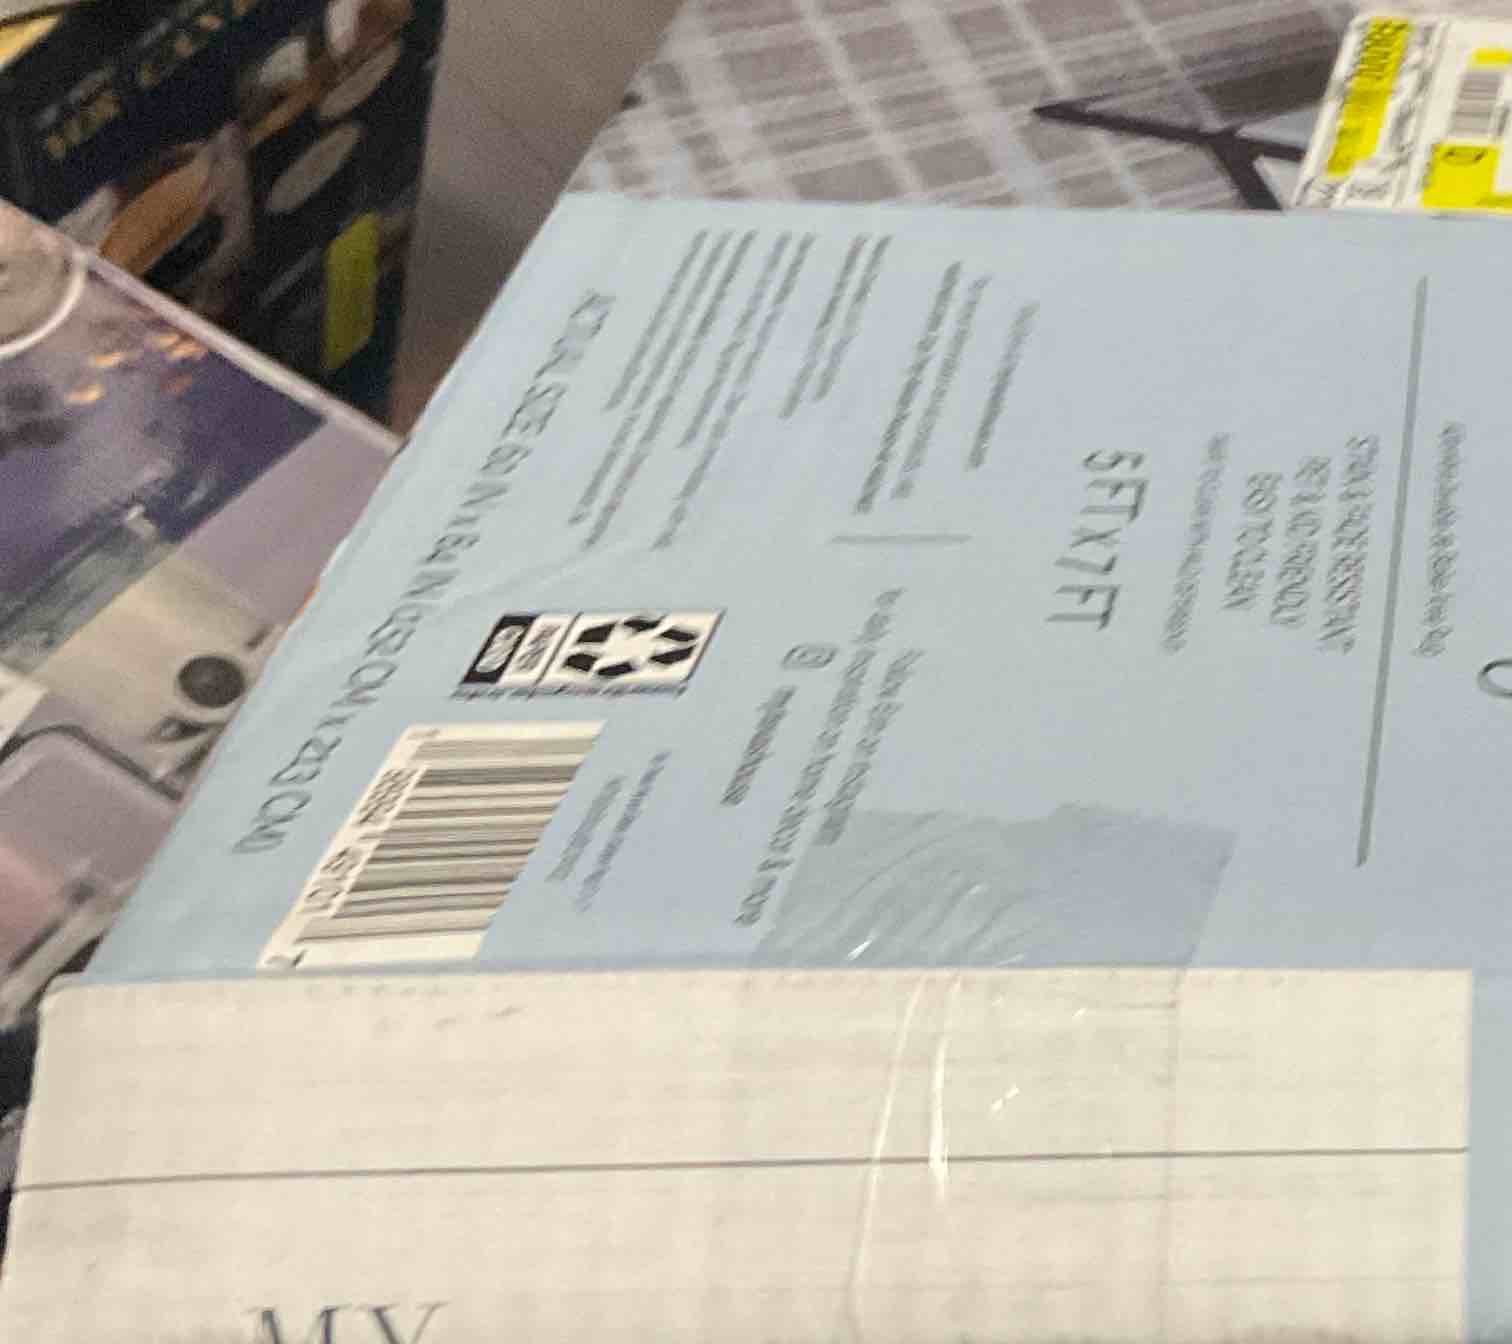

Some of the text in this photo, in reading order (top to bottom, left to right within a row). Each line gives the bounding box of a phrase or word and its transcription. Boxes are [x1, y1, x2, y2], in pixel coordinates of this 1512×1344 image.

[1081, 448, 1146, 474] 5
[1080, 477, 1149, 522] FT
[1045, 584, 1121, 631] FT
